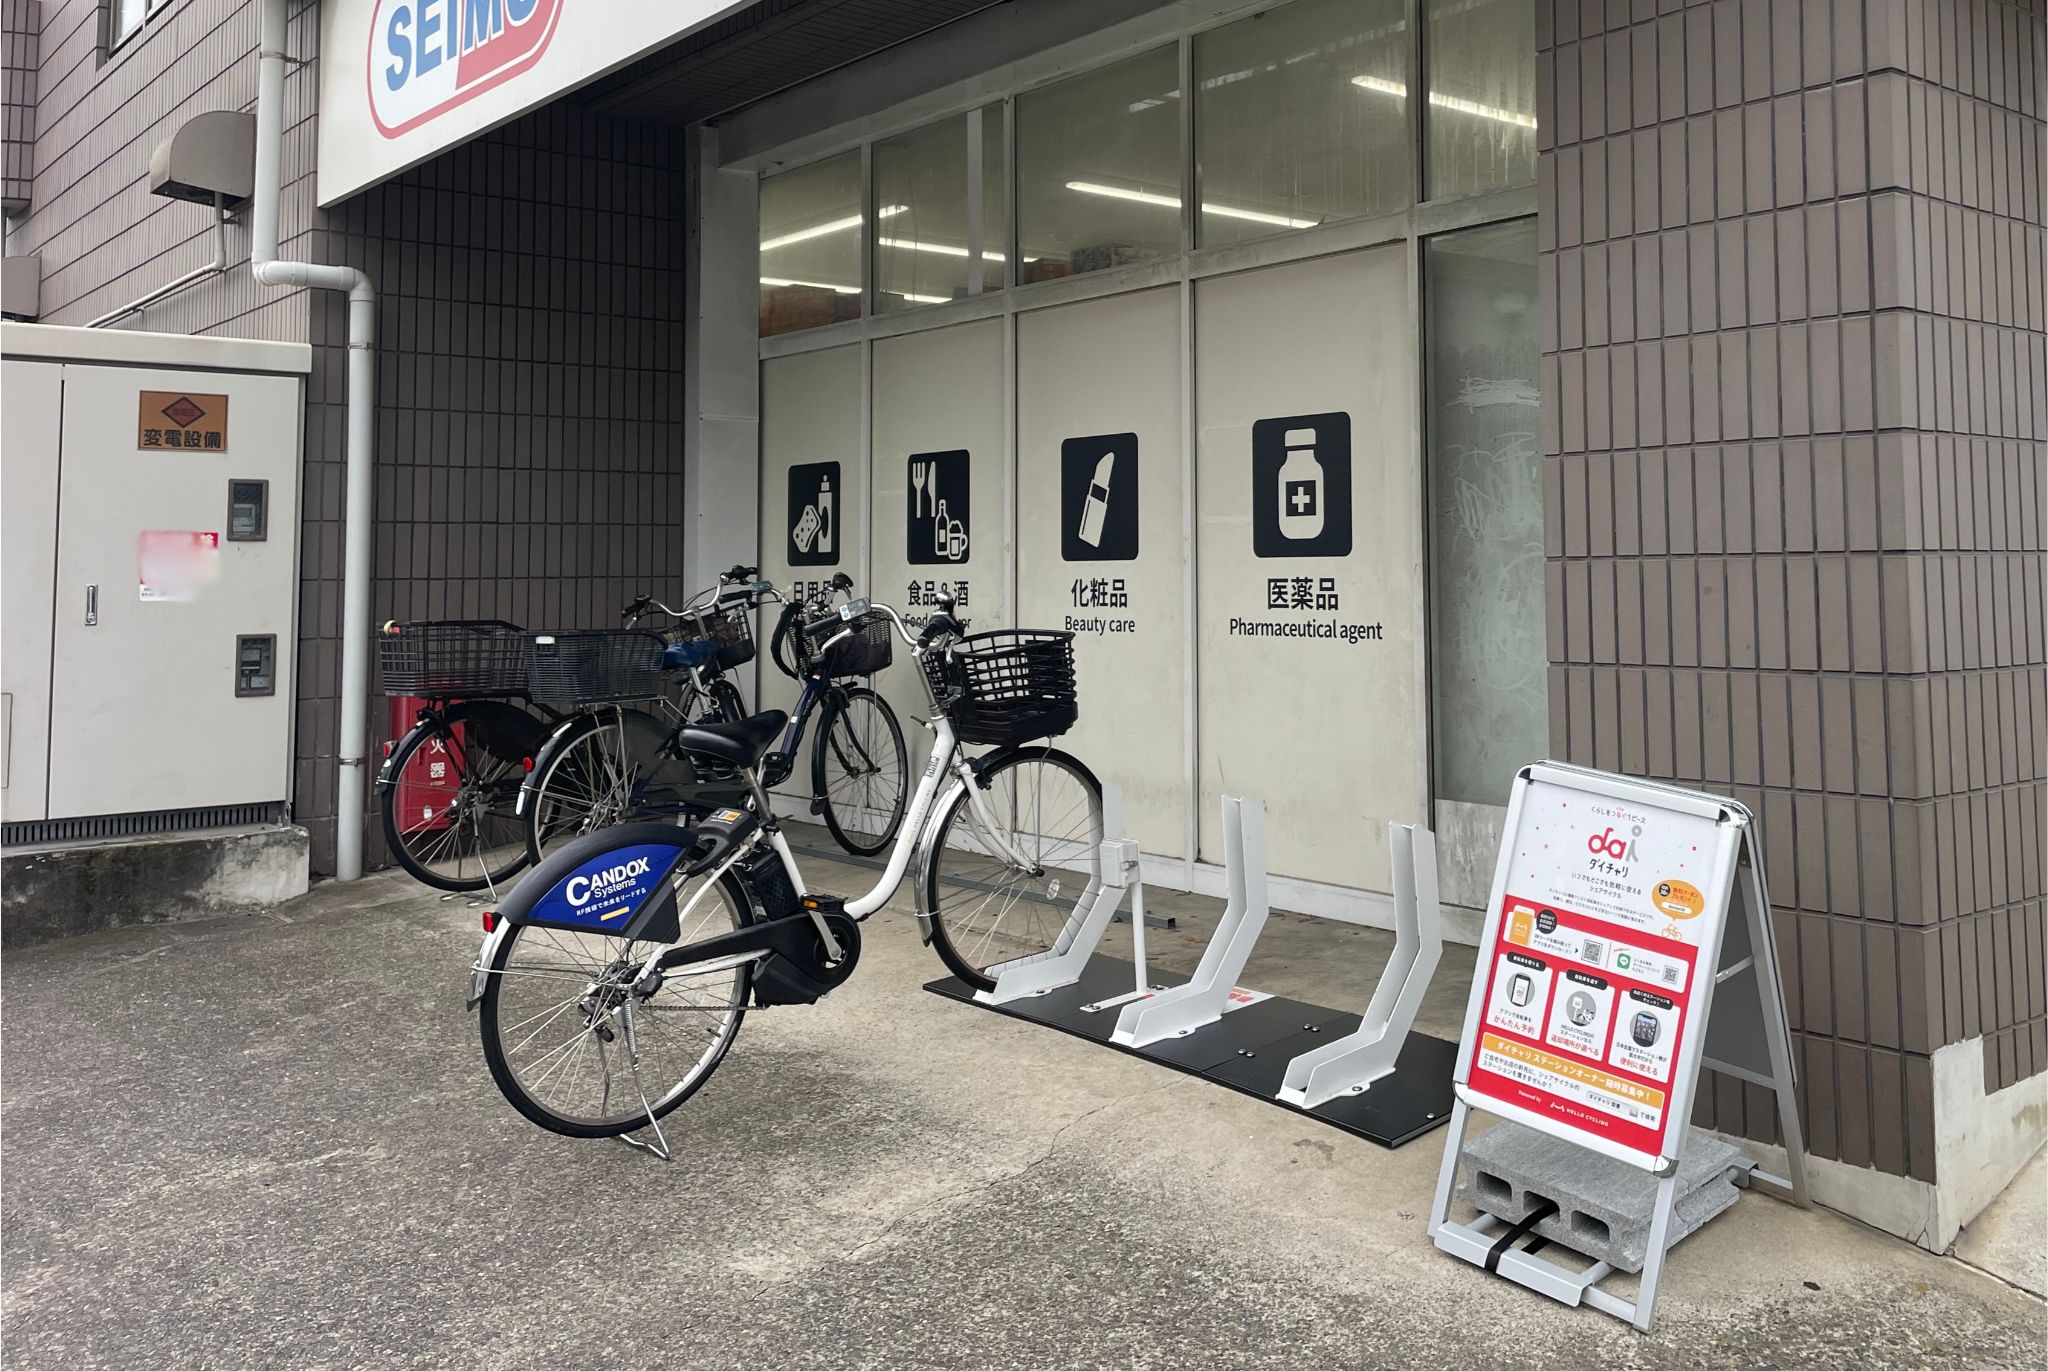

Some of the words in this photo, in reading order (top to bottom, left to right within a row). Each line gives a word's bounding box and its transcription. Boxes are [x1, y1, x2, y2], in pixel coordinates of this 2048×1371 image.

[386, 0, 537, 91] SEIM
[144, 428, 221, 448] 変電設備
[1071, 578, 1128, 608] 化粧品
[1267, 576, 1338, 610] 医薬品
[1065, 616, 1106, 636] Beauty
[1109, 620, 1136, 632] care
[1230, 616, 1337, 638] Pharmaceutical
[1340, 622, 1383, 644] agent
[1589, 858, 1629, 878] ダイチャリ
[566, 856, 651, 907] CANDOX
[594, 878, 637, 898] Systems
[1589, 885, 1622, 898] シェアサイクル
[1494, 1015, 1535, 1035] かんたん予約
[1497, 1042, 1532, 1060] ダイチャリ
[1551, 1034, 1600, 1056] 返却場所が選べる
[1620, 1057, 1658, 1076] 便利に使える
[1589, 1094, 1610, 1106] ダイチャリ
[1566, 1107, 1584, 1118] HELLO
[1586, 1115, 1609, 1127] CYCLING
